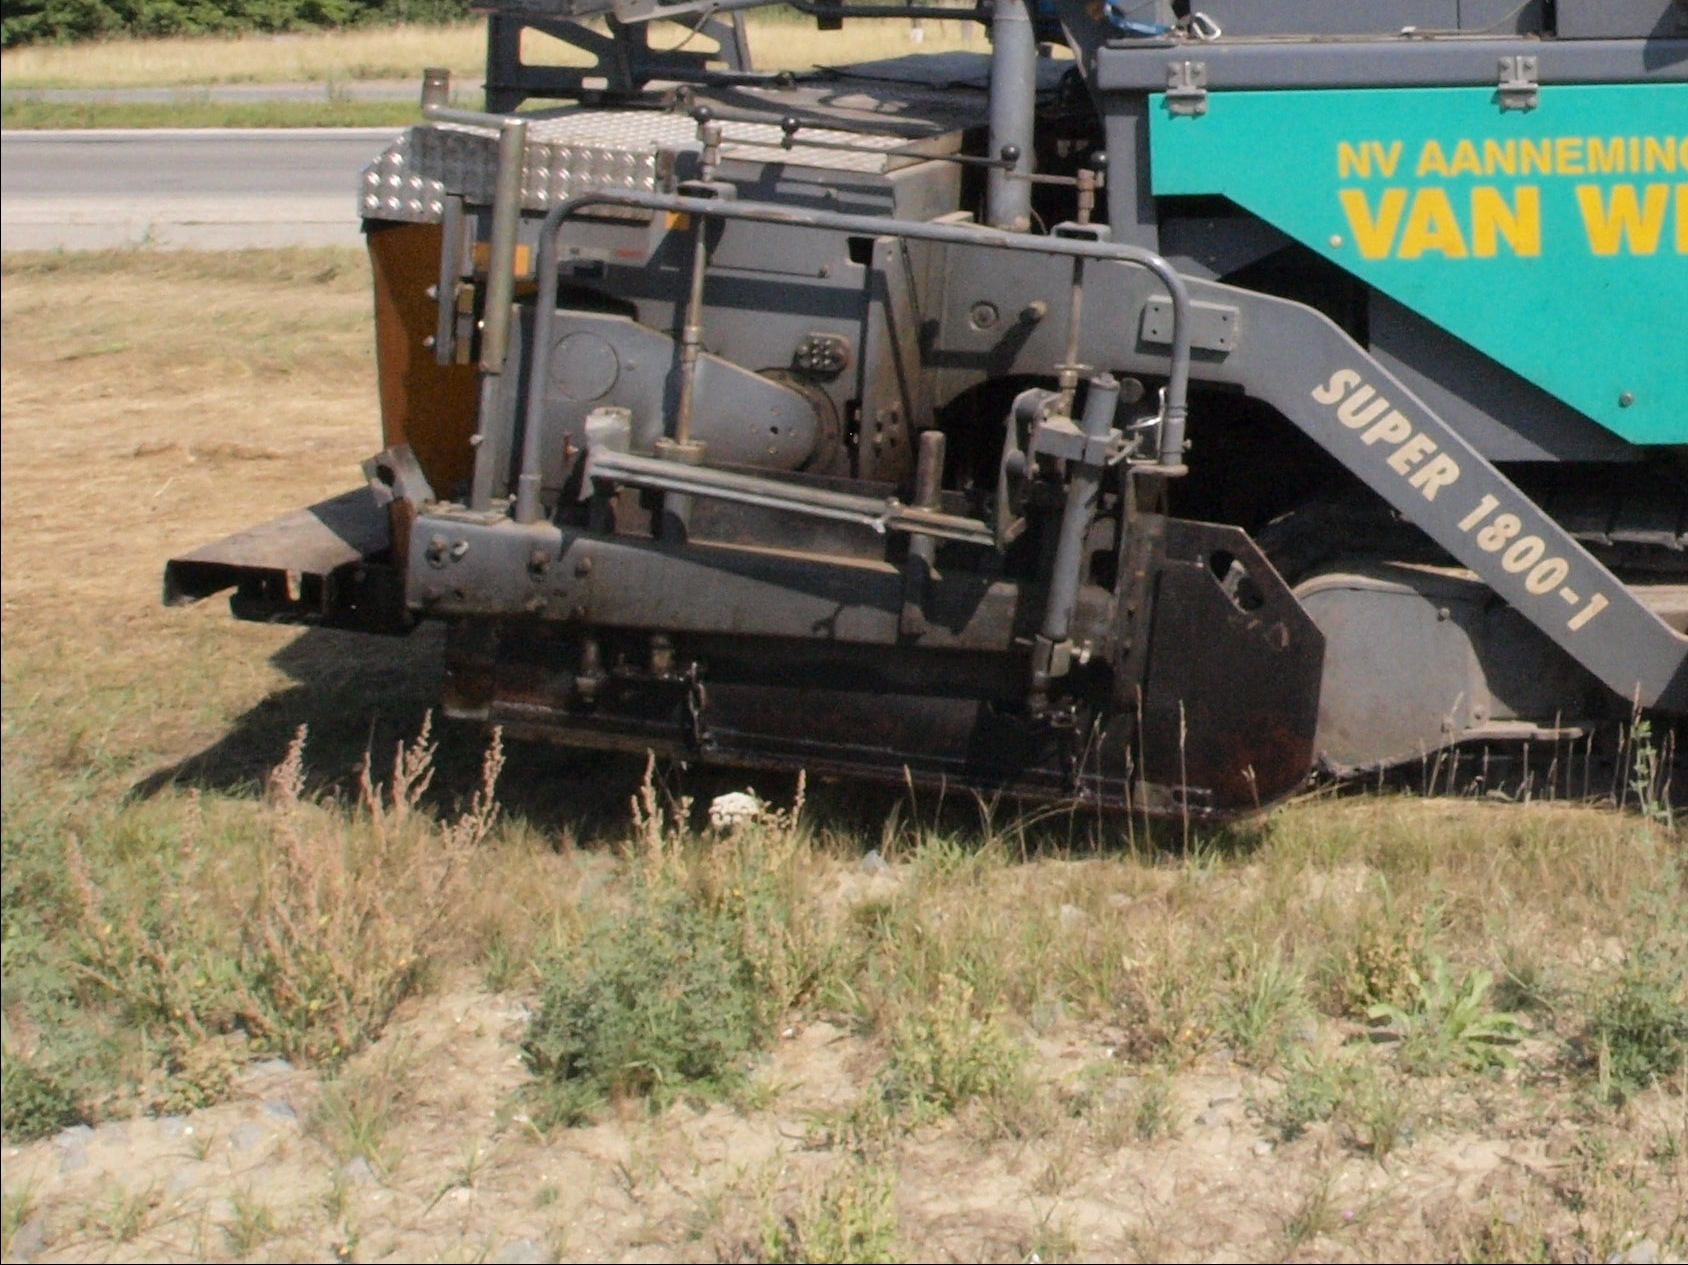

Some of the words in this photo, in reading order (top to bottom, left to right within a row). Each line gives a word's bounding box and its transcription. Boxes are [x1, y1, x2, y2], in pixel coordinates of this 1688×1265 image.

[1340, 144, 1401, 177] NV
[1340, 187, 1541, 259] VAN
[1311, 368, 1461, 502] SUPER
[1457, 493, 1609, 632] 1800-1
